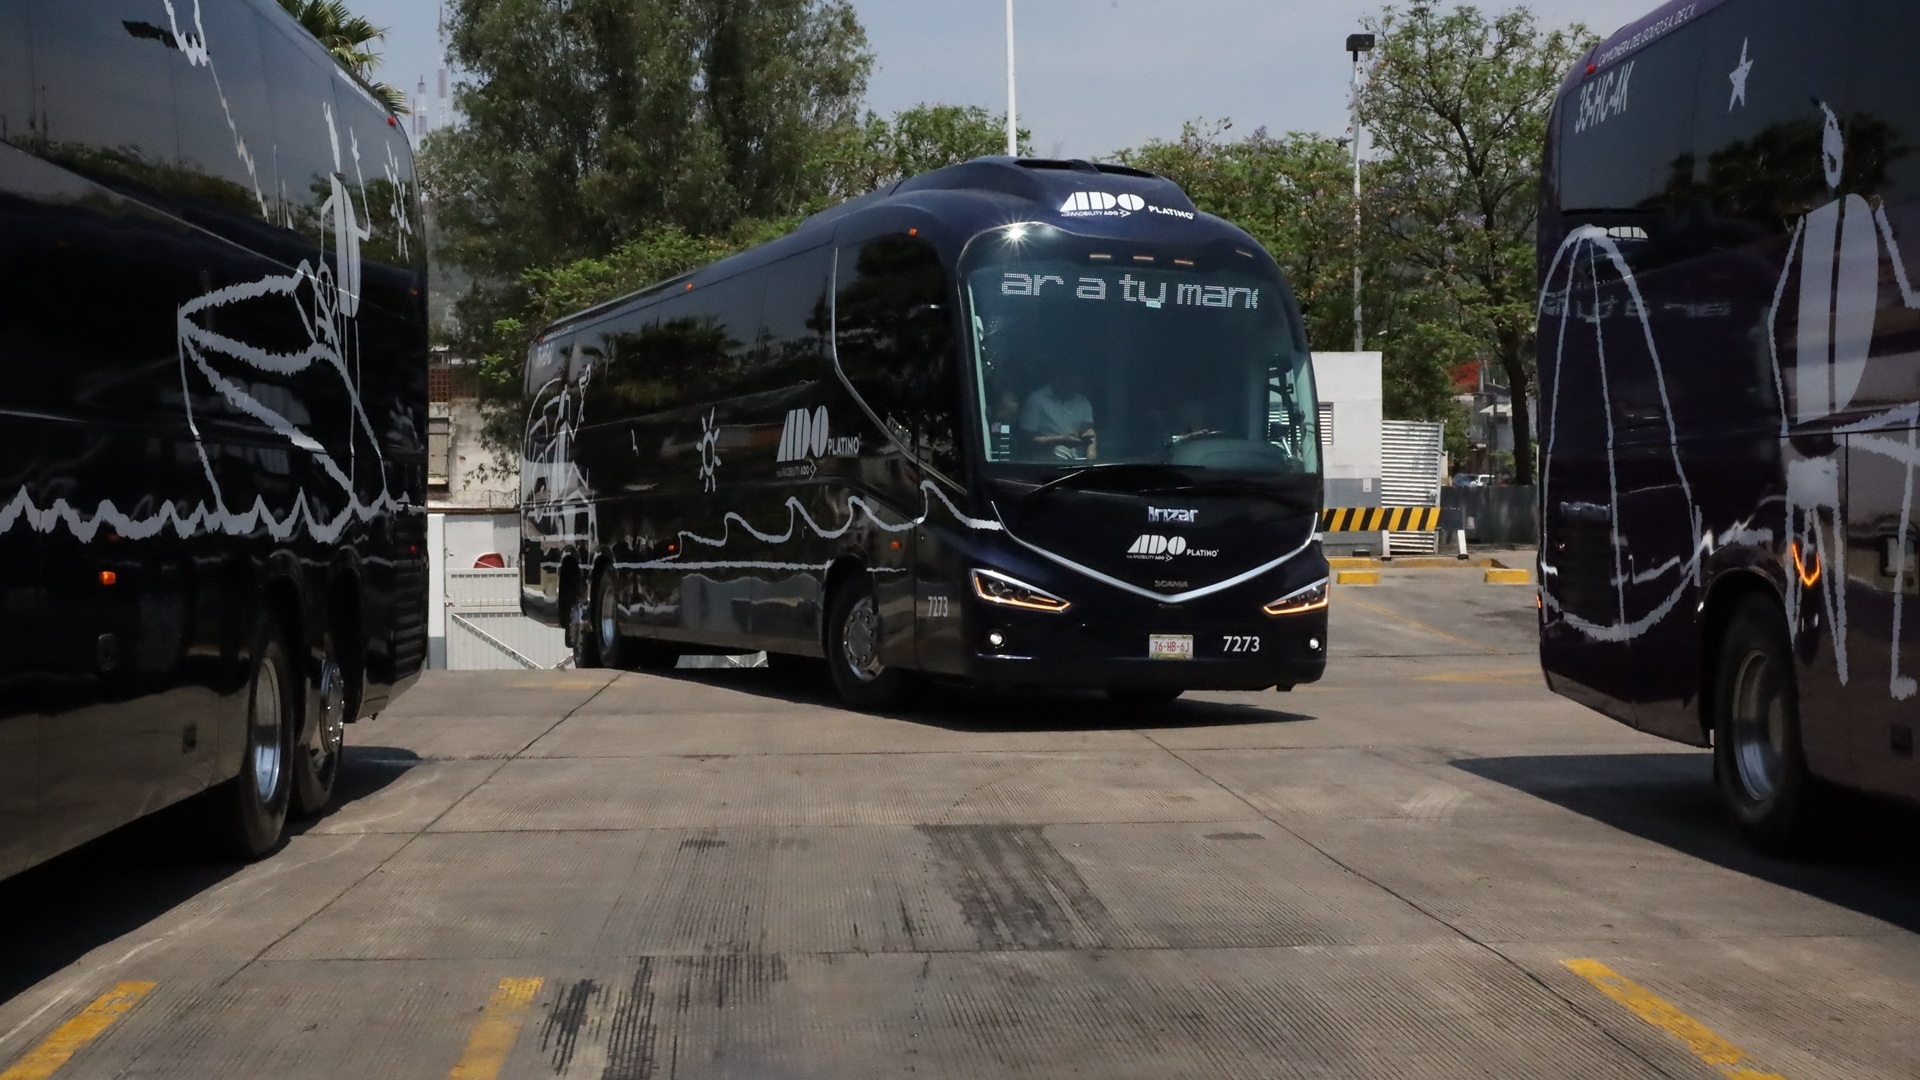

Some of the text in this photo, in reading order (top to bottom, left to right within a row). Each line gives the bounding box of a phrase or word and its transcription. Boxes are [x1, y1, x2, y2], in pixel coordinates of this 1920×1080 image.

[1575, 60, 1635, 134] 35-HC-4K
[1060, 191, 1145, 211] ADO
[1002, 273, 1064, 296] ar
[1076, 277, 1107, 300] a
[776, 405, 860, 462] ADO PLATINO
[1127, 534, 1186, 555] ADO
[1154, 580, 1188, 588] SCANIA
[928, 596, 949, 617] 7273
[1153, 641, 1190, 652] 76-HB-6J
[1223, 636, 1260, 652] 7273
